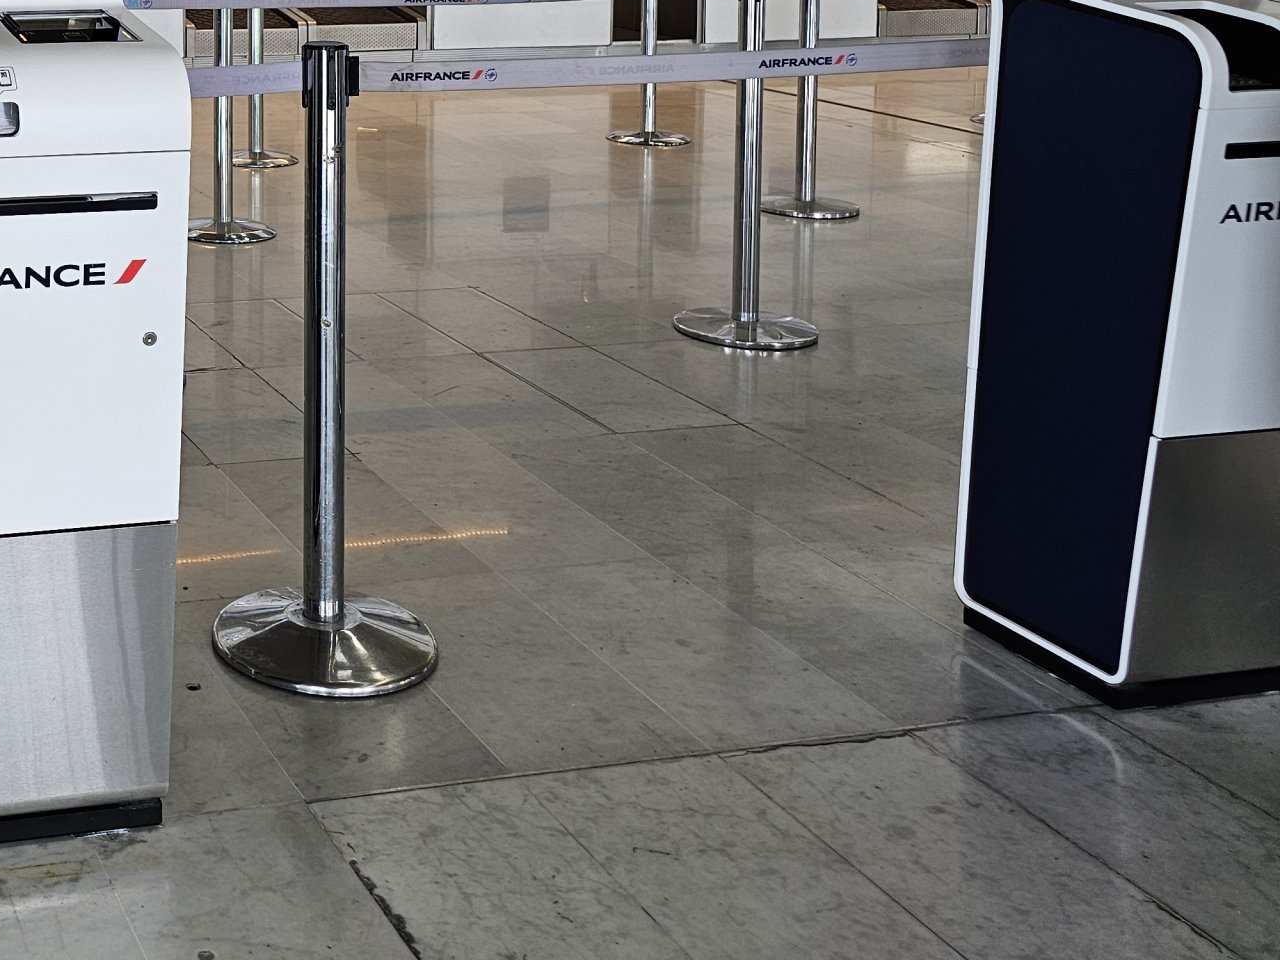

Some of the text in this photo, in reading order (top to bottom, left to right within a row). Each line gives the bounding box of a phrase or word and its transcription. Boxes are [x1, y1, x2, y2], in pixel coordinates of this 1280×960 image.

[758, 56, 833, 69] AIRFRANCE
[390, 71, 470, 82] AIRFRANCE
[1219, 201, 1280, 224] AIR
